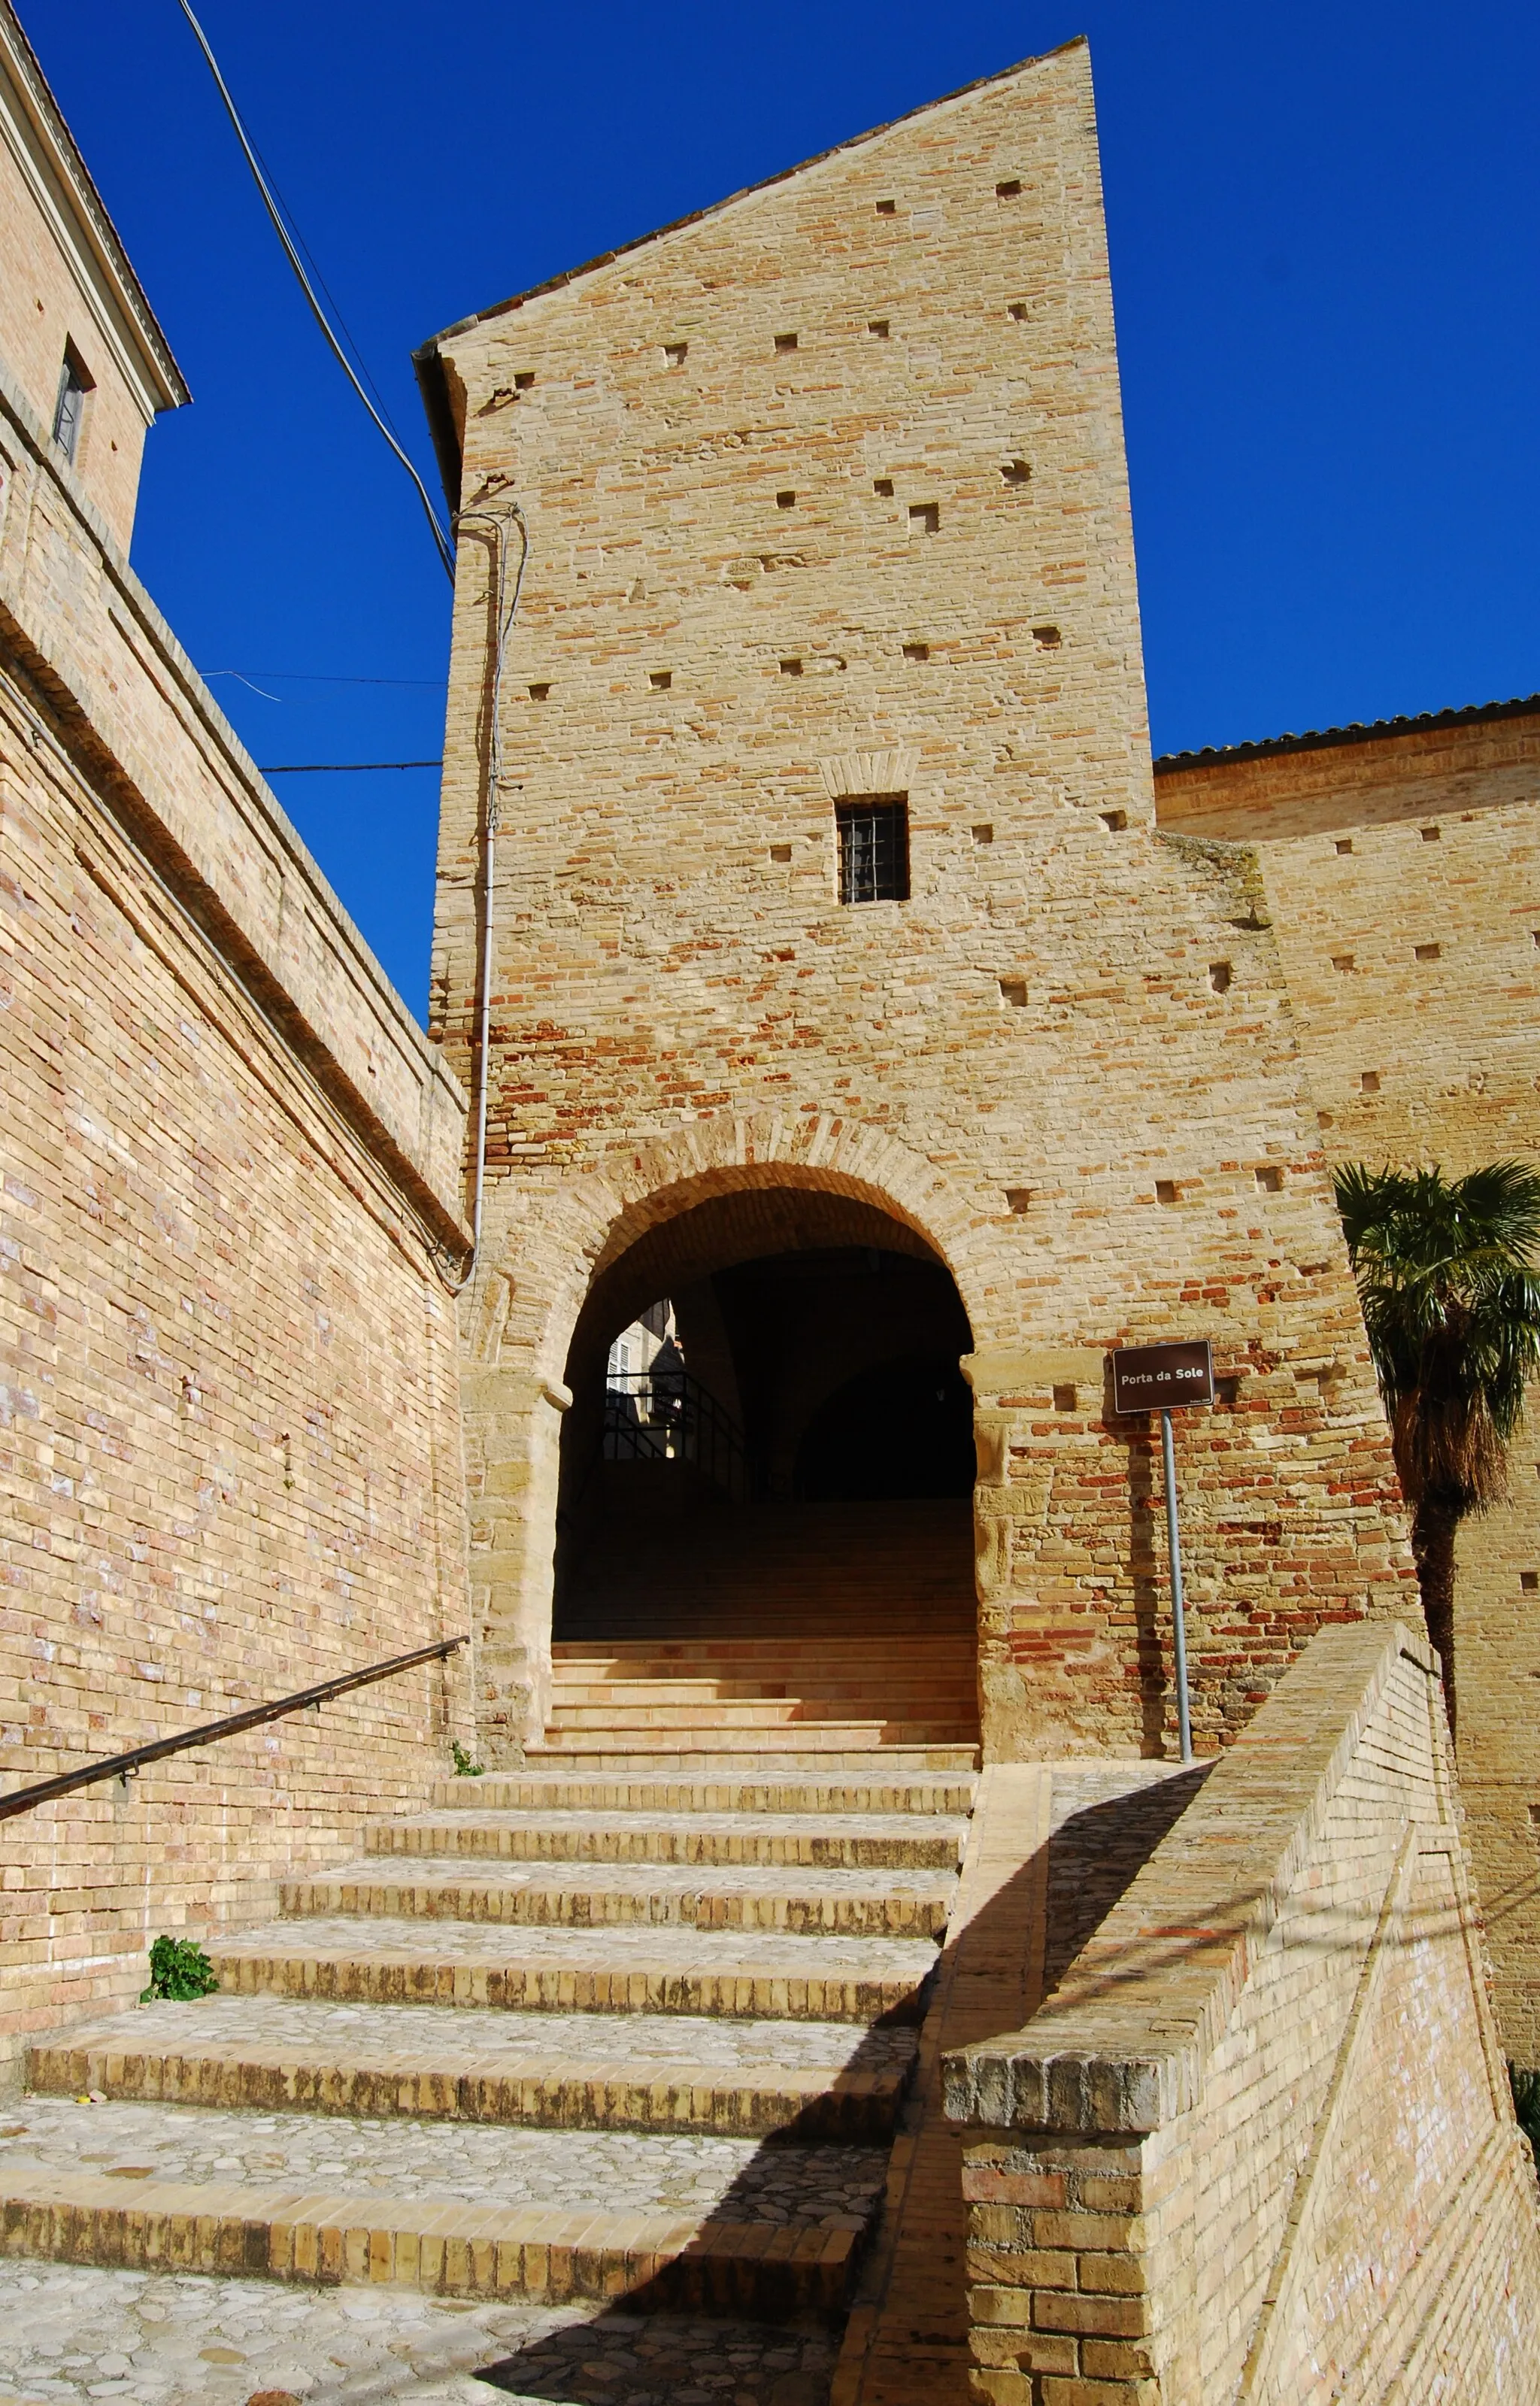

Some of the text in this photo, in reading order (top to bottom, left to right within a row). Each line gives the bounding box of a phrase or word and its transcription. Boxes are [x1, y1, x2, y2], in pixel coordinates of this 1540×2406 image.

[1122, 1367, 1203, 1385] Porta da Sole
